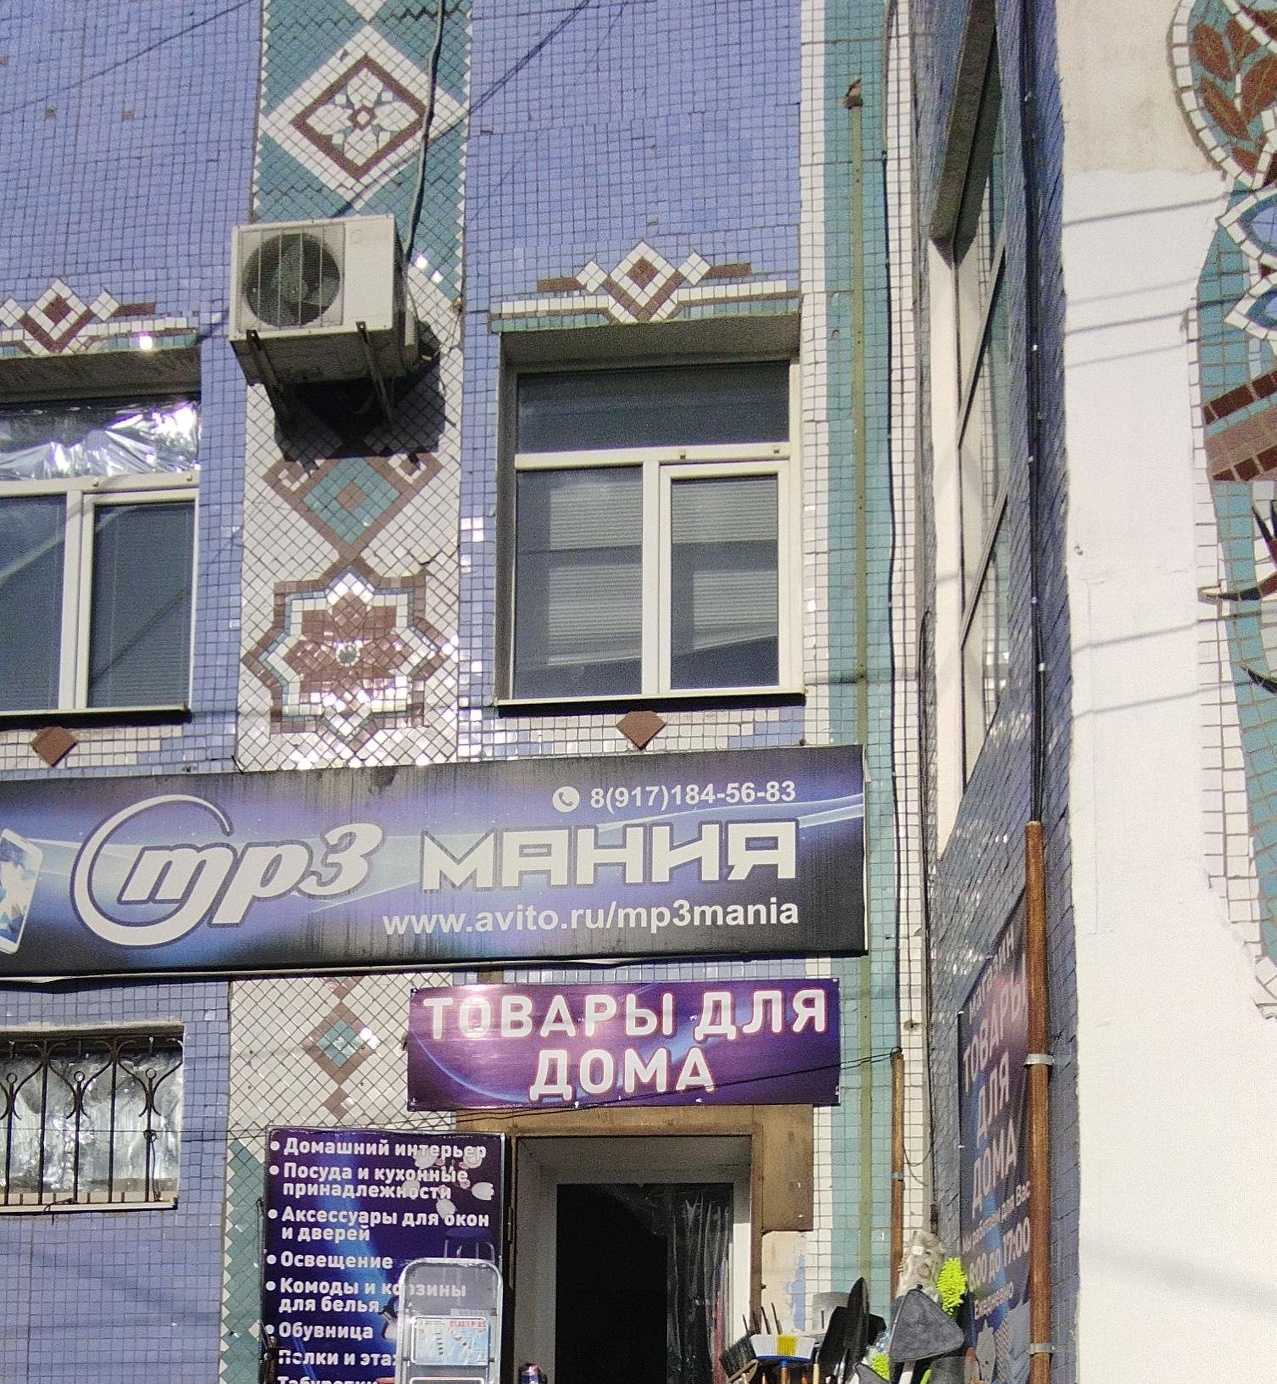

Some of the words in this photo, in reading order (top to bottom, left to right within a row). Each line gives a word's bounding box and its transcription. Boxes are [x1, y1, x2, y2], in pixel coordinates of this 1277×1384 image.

[590, 781, 797, 811] 8(917)184-56-83
[421, 818, 800, 891] МАНИЯ
[72, 794, 384, 946] mp3
[382, 896, 799, 936] www.avito.ru/mp3mania
[423, 992, 674, 1040] ТОВАРЫ
[694, 989, 826, 1040] ДЛЯ
[528, 1047, 714, 1102] ДОМА
[976, 1052, 1010, 1149] ДЛЯ
[283, 1138, 390, 1157] Домашний
[394, 1142, 487, 1160] интерьер
[283, 1162, 352, 1181] Посуда
[357, 1167, 370, 1180] и
[374, 1167, 469, 1184] кухонные
[972, 1118, 1017, 1219] ДОМА
[283, 1182, 452, 1201] принадлежности
[281, 1206, 398, 1226] Аксессуары
[401, 1212, 439, 1228] для
[444, 1213, 490, 1228] окон
[281, 1227, 293, 1240] и
[297, 1226, 371, 1242] дверей
[280, 1251, 394, 1270] Освещение
[280, 1277, 359, 1296] Комоды
[364, 1282, 376, 1295] и
[278, 1299, 317, 1314] для
[320, 1296, 380, 1313] белья
[278, 1321, 374, 1341] Обувница
[278, 1349, 339, 1366] Полки
[343, 1352, 356, 1366] и
[360, 1353, 397, 1367] эта
